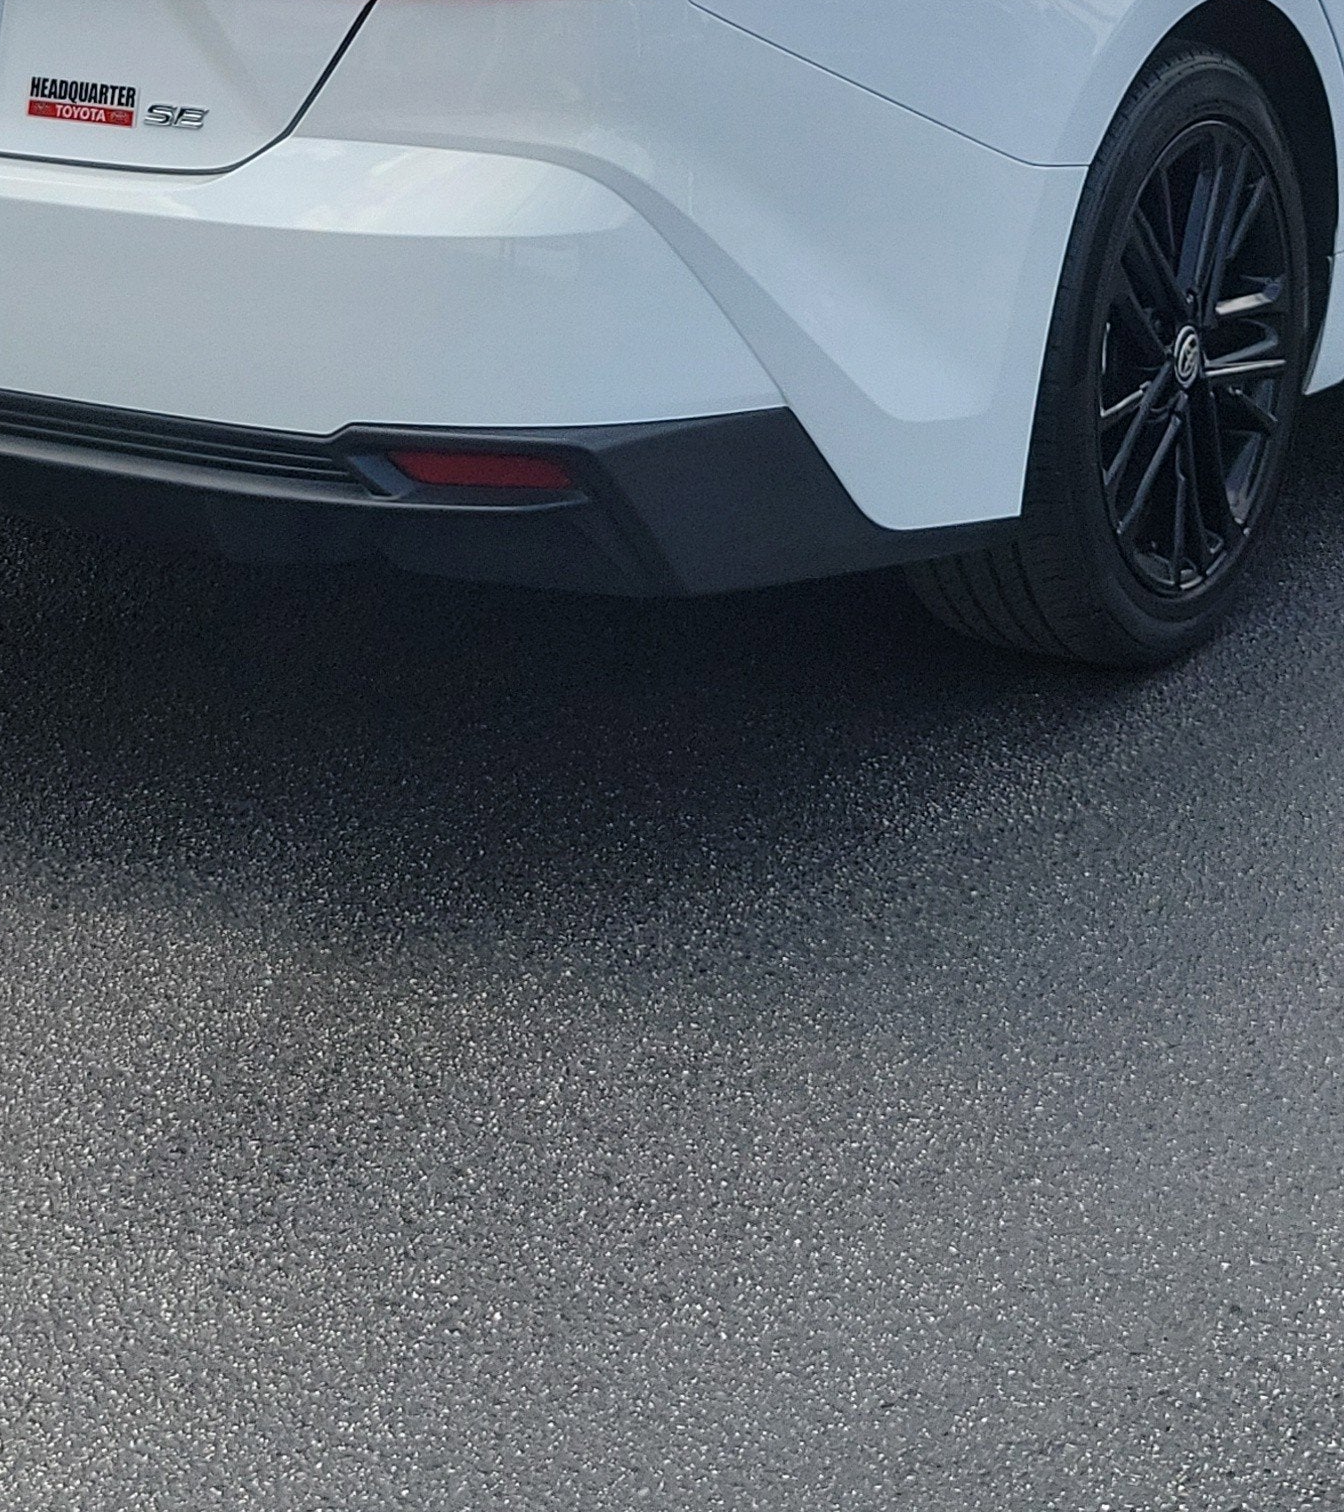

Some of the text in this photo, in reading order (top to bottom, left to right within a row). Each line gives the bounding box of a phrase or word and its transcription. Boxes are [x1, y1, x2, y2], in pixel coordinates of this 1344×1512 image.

[29, 76, 136, 108] HEADQUARTER
[55, 104, 106, 122] TOYOTA
[143, 103, 210, 130] SE
